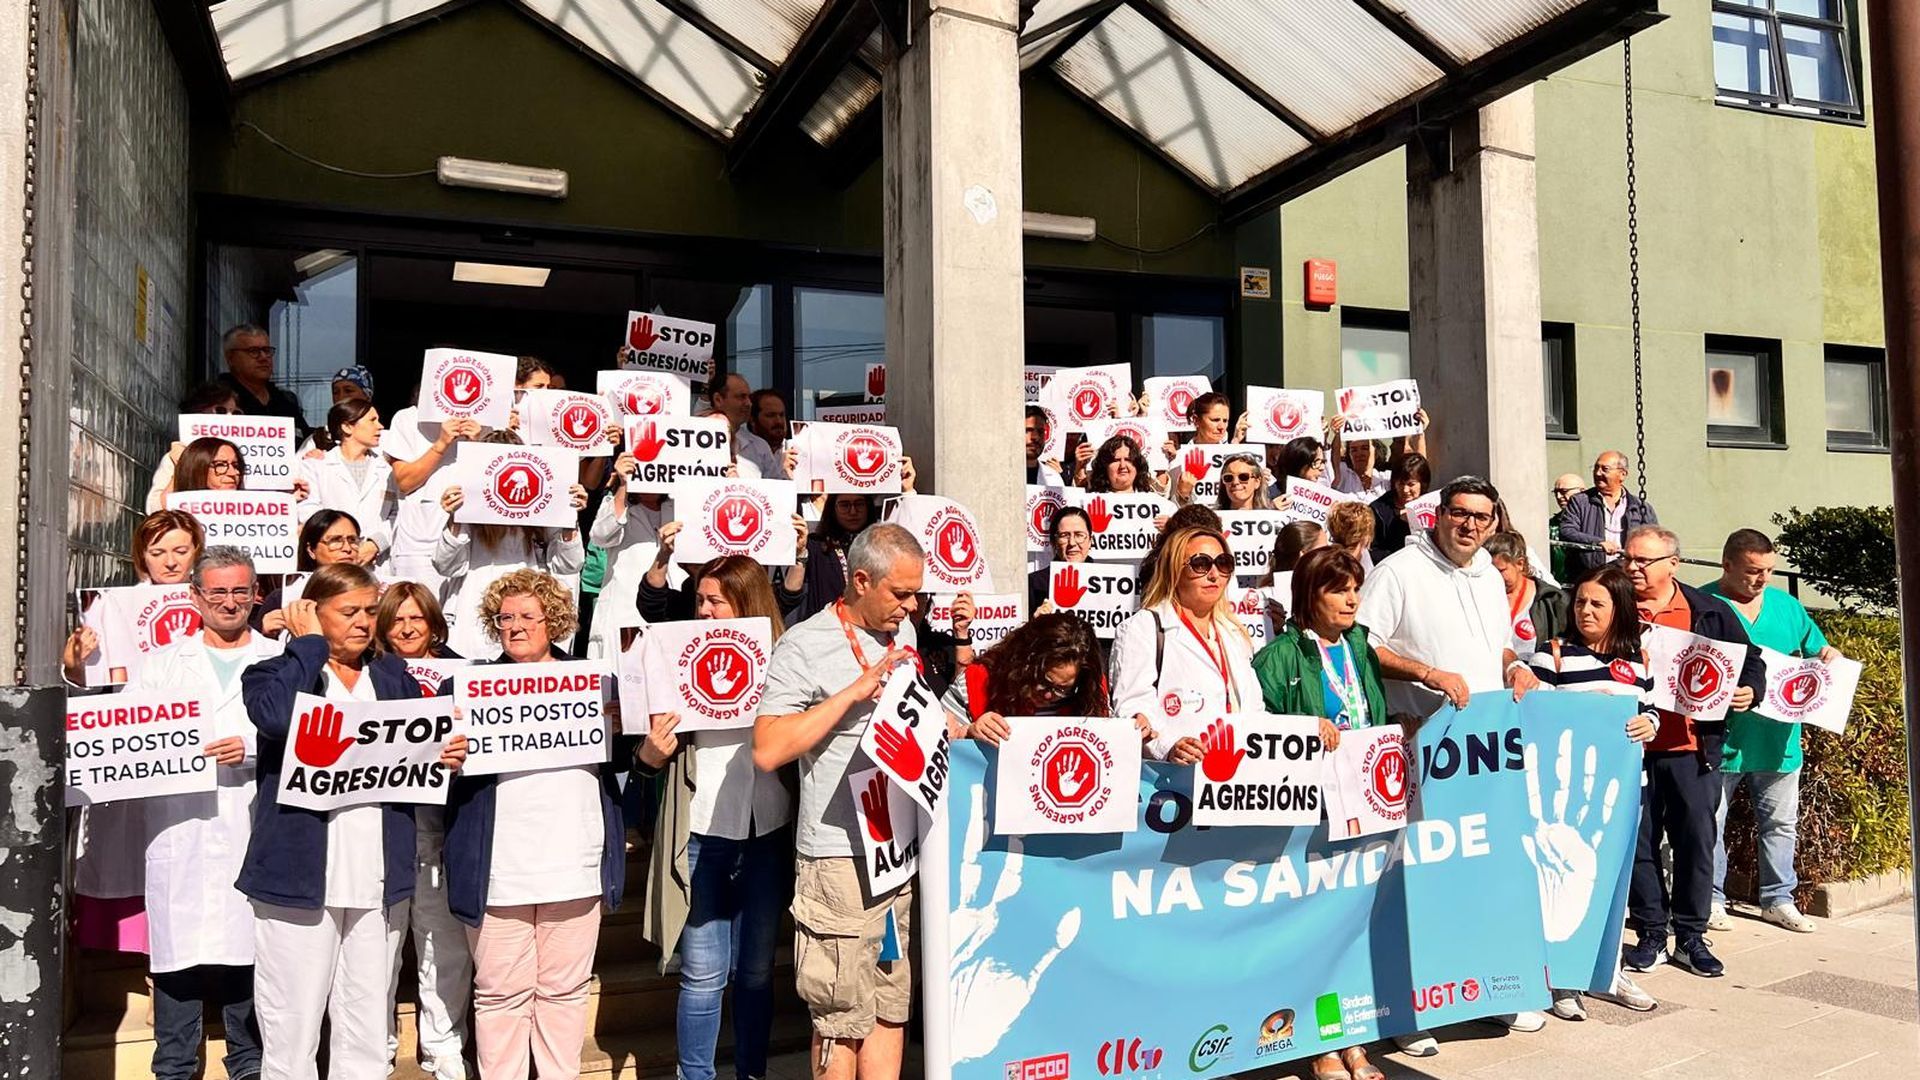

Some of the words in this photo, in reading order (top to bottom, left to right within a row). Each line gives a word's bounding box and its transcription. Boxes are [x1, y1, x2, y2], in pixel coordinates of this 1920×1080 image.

[659, 326, 712, 347] STOP
[625, 350, 708, 375] AGRESIÓNS
[823, 411, 886, 424] SEGURIDAD
[191, 424, 287, 439] SEGURIDADE
[666, 428, 727, 449] STOP
[485, 455, 504, 476] STOP
[179, 501, 289, 516] SEGURIDADE
[533, 492, 553, 514] STOP
[702, 489, 721, 513] STOP
[1113, 503, 1160, 519] STOP
[224, 523, 289, 537] POSTOS
[925, 510, 943, 537] STOP
[753, 529, 772, 552] STOP
[137, 600, 158, 627] STOP
[932, 605, 1017, 620] SERIDADE
[678, 636, 701, 668] STOP
[705, 628, 767, 667] AGRESIÓNS
[1673, 645, 1695, 665] STOP
[467, 674, 600, 699] SEGURIDADE
[471, 706, 513, 727] NOS
[520, 700, 599, 722] POSTOS
[679, 683, 739, 720] AGRESIÓNS
[66, 701, 200, 731] EGURIDADE
[112, 729, 200, 755] POSTOS
[356, 715, 453, 745] STOP
[467, 737, 493, 755] DE
[499, 728, 604, 752] TRABALLO
[1031, 735, 1053, 767] STOP
[1057, 726, 1113, 769] AGRESIÓNS
[1246, 733, 1321, 761] STOP
[1362, 743, 1376, 773] STOP
[89, 755, 207, 784] TRABALLO
[285, 757, 446, 796] AGRESIÓNS
[1029, 784, 1084, 824] AGRESIÓNS
[1088, 787, 1111, 817] STOP
[1198, 775, 1318, 811] AGRESIÓNS
[1112, 865, 1203, 920] NA
[1224, 812, 1491, 908] SANIDADE
[1411, 981, 1457, 1012] UGT
[1024, 1057, 1067, 1080] CCOO
